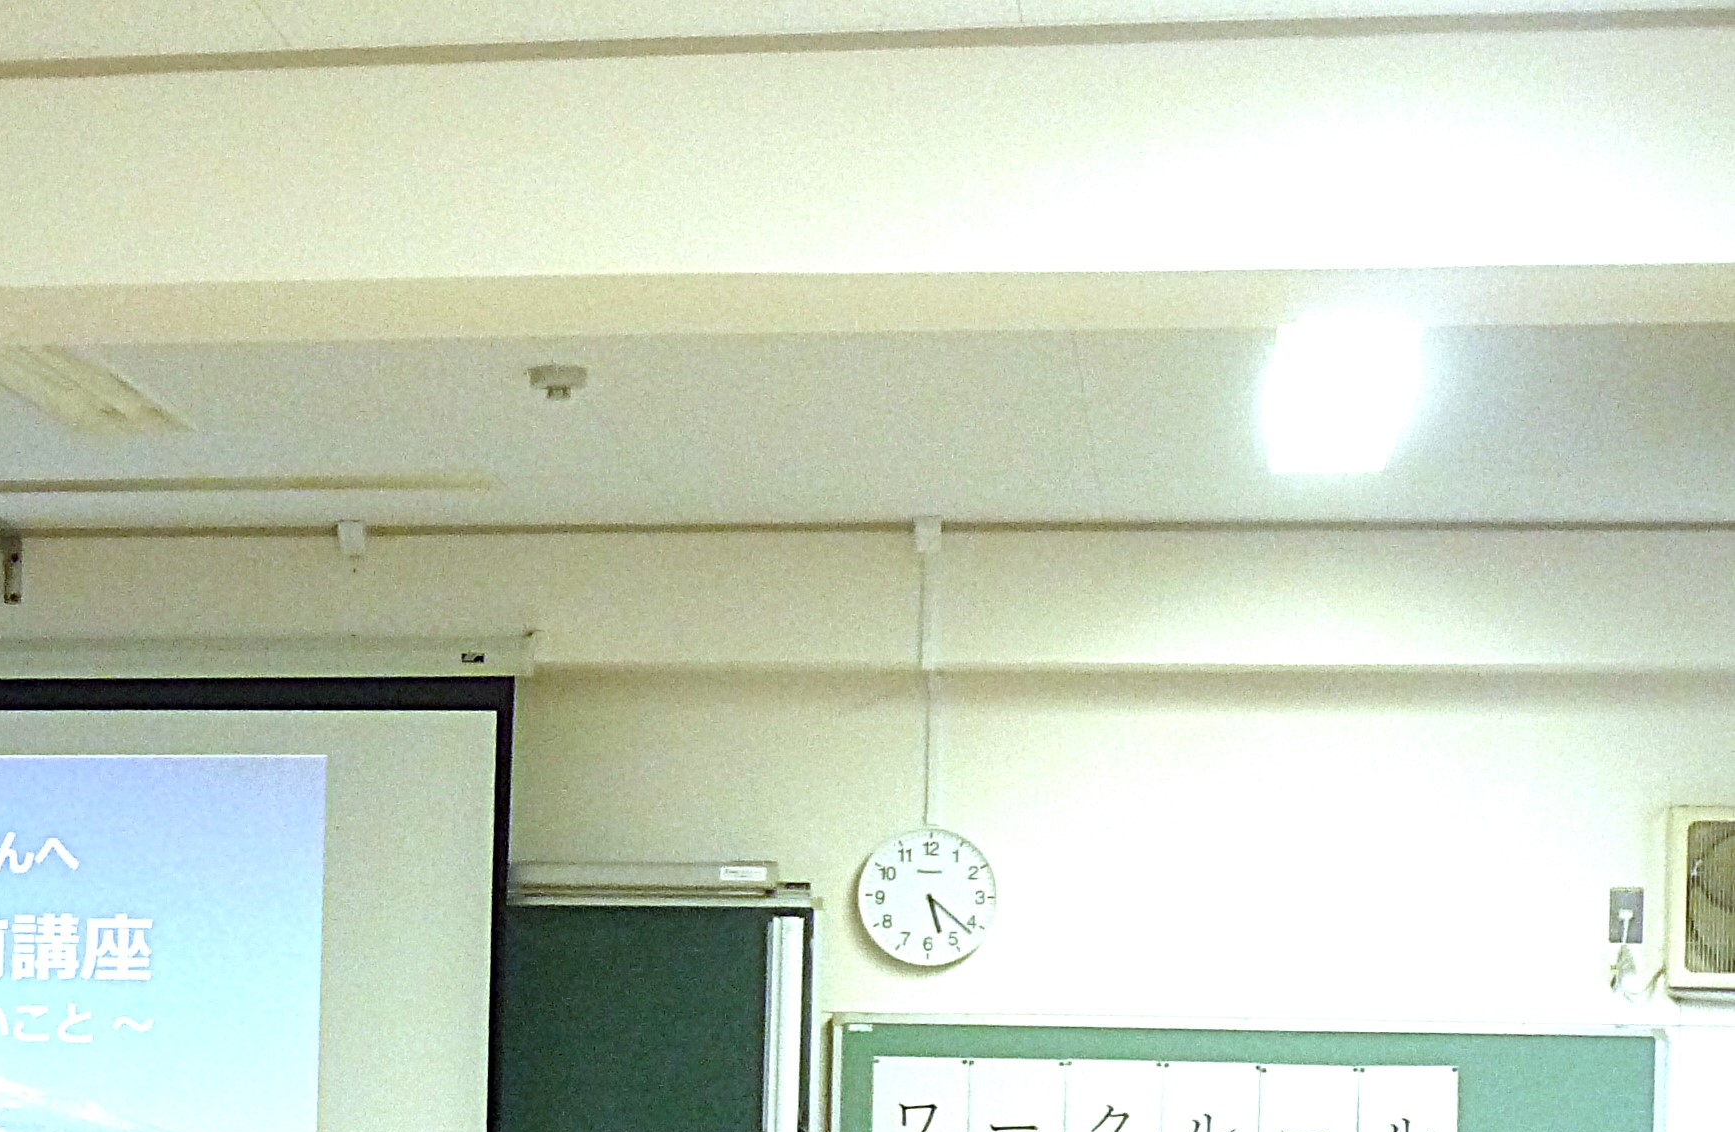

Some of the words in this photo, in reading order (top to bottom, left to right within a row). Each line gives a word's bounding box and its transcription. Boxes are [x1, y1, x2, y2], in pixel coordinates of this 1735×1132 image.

[898, 848, 912, 862] 11
[923, 841, 939, 856] 12
[952, 848, 959, 863] 1
[878, 866, 896, 881] 10
[967, 865, 979, 880] 2
[874, 889, 885, 905] 9
[975, 890, 985, 905] 3
[881, 913, 893, 929] 8
[966, 914, 977, 929] 4
[899, 931, 911, 946] 7
[922, 936, 933, 951] 6
[948, 931, 959, 946] 5
